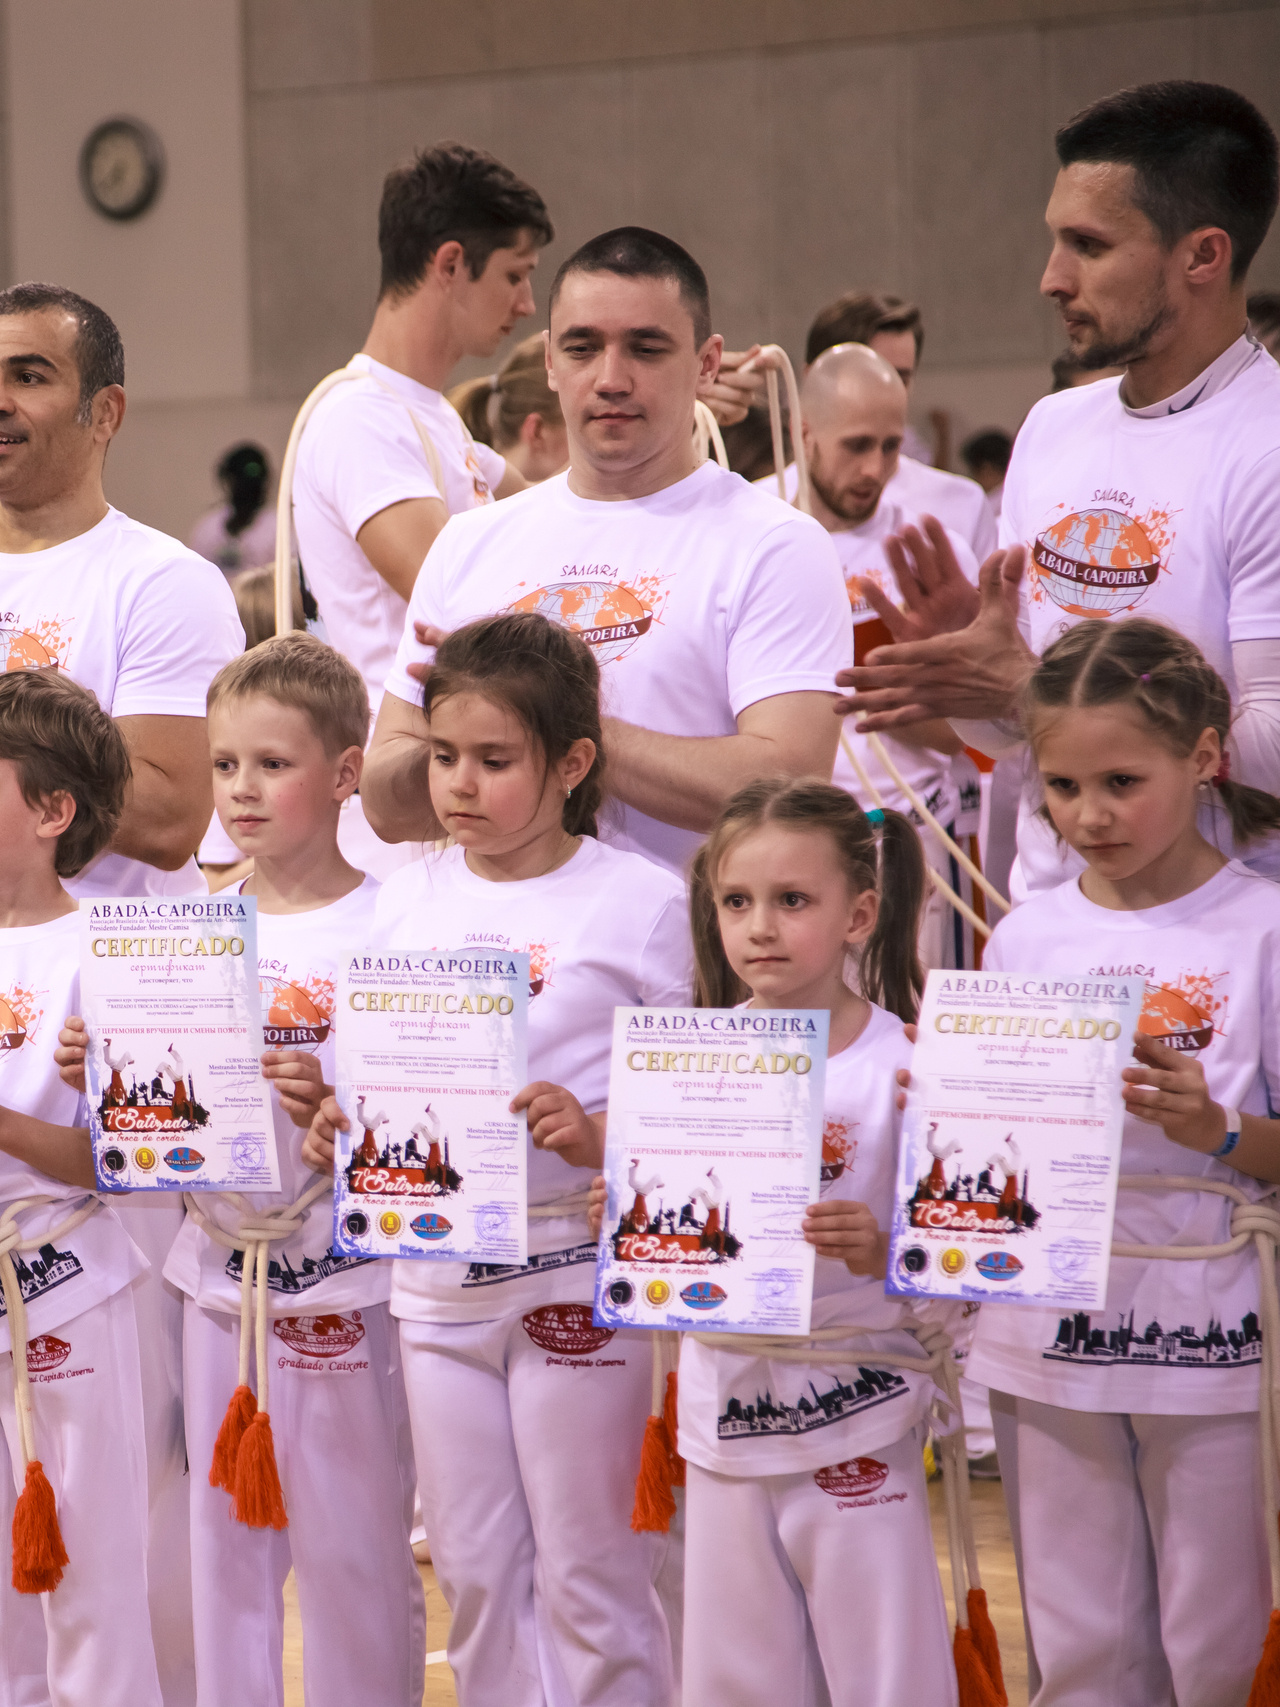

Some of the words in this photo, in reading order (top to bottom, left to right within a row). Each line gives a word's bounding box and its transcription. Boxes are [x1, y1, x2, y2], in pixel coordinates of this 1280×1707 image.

[560, 564, 619, 578] SAMARA
[1037, 549, 1148, 585] ABADÁ-CAPOEIRA
[90, 901, 247, 917] ABADÁ-CAPOEIRA
[92, 936, 245, 957] CERTIFICADO
[130, 959, 205, 977] сертификат
[349, 954, 518, 974] ABADÁ-CAPOEIRA
[348, 977, 379, 985] Presidente
[433, 979, 455, 987] Camisa
[940, 977, 1130, 999] ABADÁ-CAPOEIRA
[349, 991, 514, 1016] CERTIFICADO
[390, 1016, 470, 1034] сертификат
[627, 1012, 817, 1032] ABADÁ-CAPOEIRA
[934, 1012, 1121, 1041] CERTIFICADO
[627, 1050, 812, 1075] CERTIFICADO
[356, 1084, 402, 1093] ЦЕРЕМОНИЯ
[403, 1086, 441, 1094] ВРУЧЕНИЯ
[479, 1089, 510, 1097] ПОЯСОВ
[115, 1108, 191, 1131] Batizado
[156, 1134, 185, 1142] cordas
[363, 1169, 442, 1195] Batizado
[630, 1236, 719, 1263] Batizado
[278, 1357, 323, 1371] Graduado
[329, 1360, 368, 1373] Caixote
